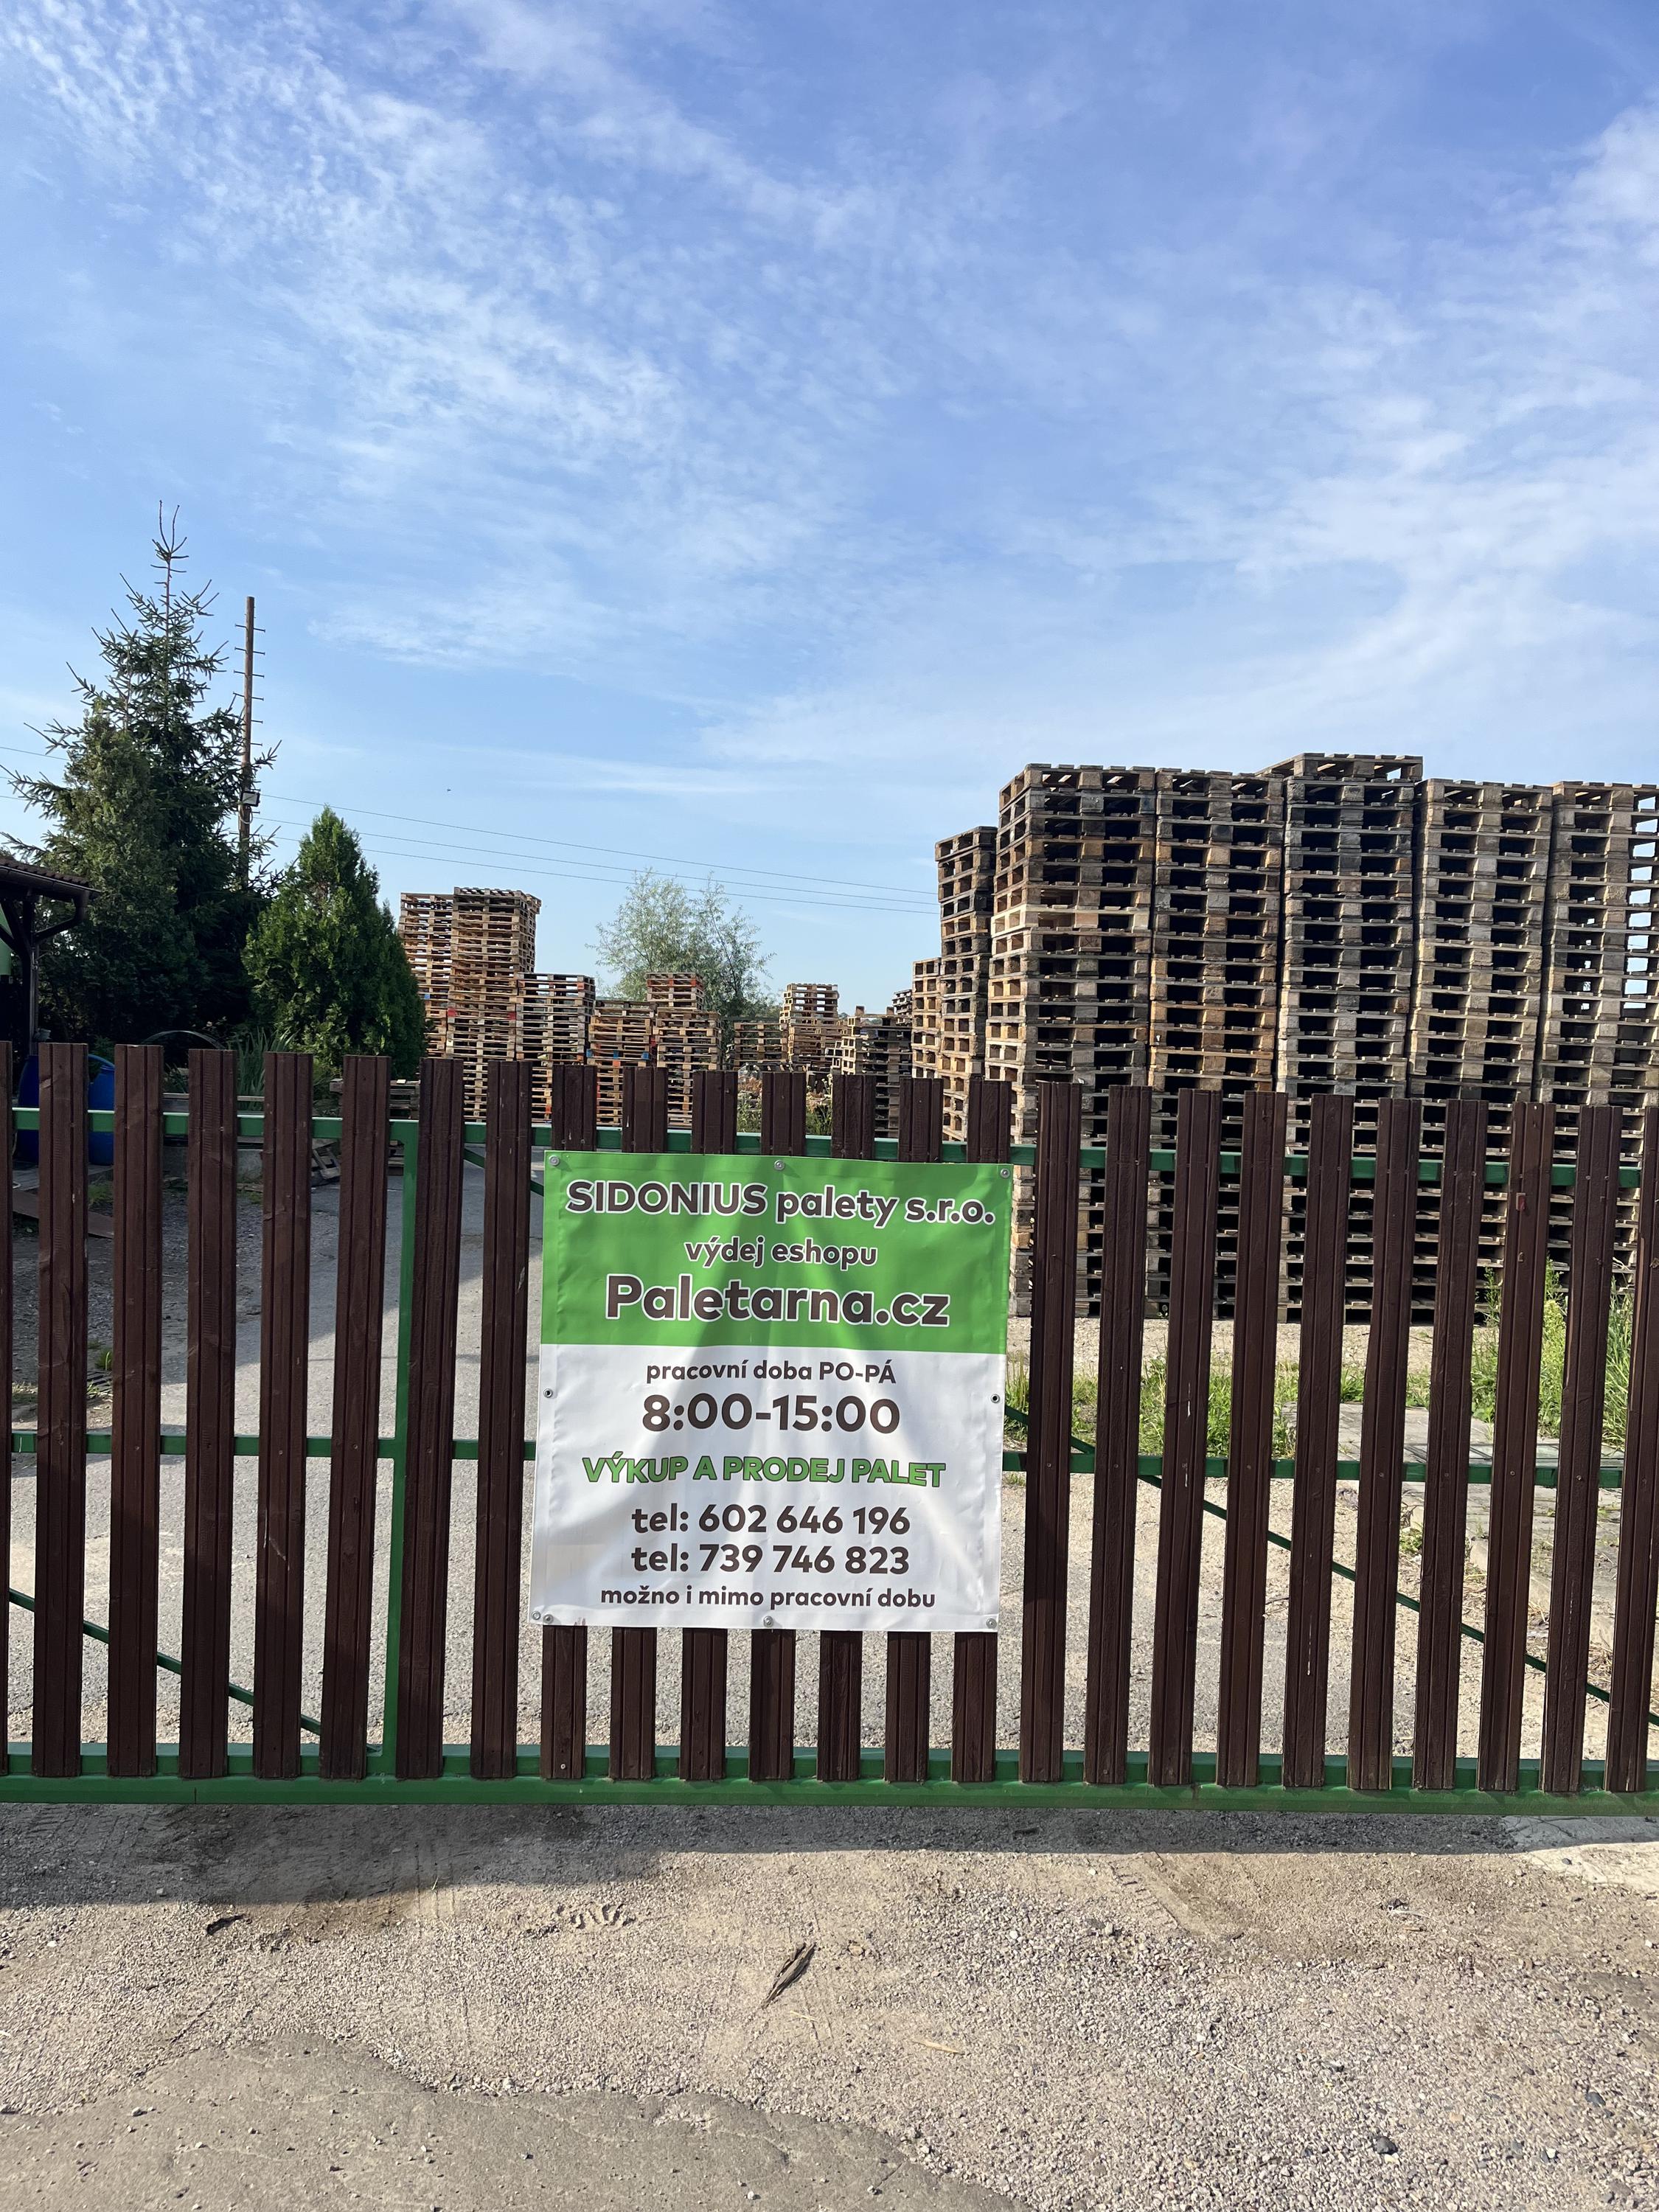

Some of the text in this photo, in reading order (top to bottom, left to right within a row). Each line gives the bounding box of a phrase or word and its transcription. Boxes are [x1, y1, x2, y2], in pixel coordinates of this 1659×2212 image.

[566, 1180, 995, 1228] SIDONIUS palety s.r.o.
[684, 1236, 877, 1270] výdej eshopu
[605, 1274, 950, 1327] Paletarna.cz
[647, 1359, 897, 1384] pracovní doba PO-PÁ
[642, 1392, 900, 1434] 8:00-15:00
[581, 1450, 947, 1488] VÝKUP A PRODEJ PALET
[631, 1503, 911, 1535] tel: 602 646 196
[630, 1543, 909, 1575] tel: 739 746 823
[601, 1585, 935, 1610] možno i mimo pracovní dobu
